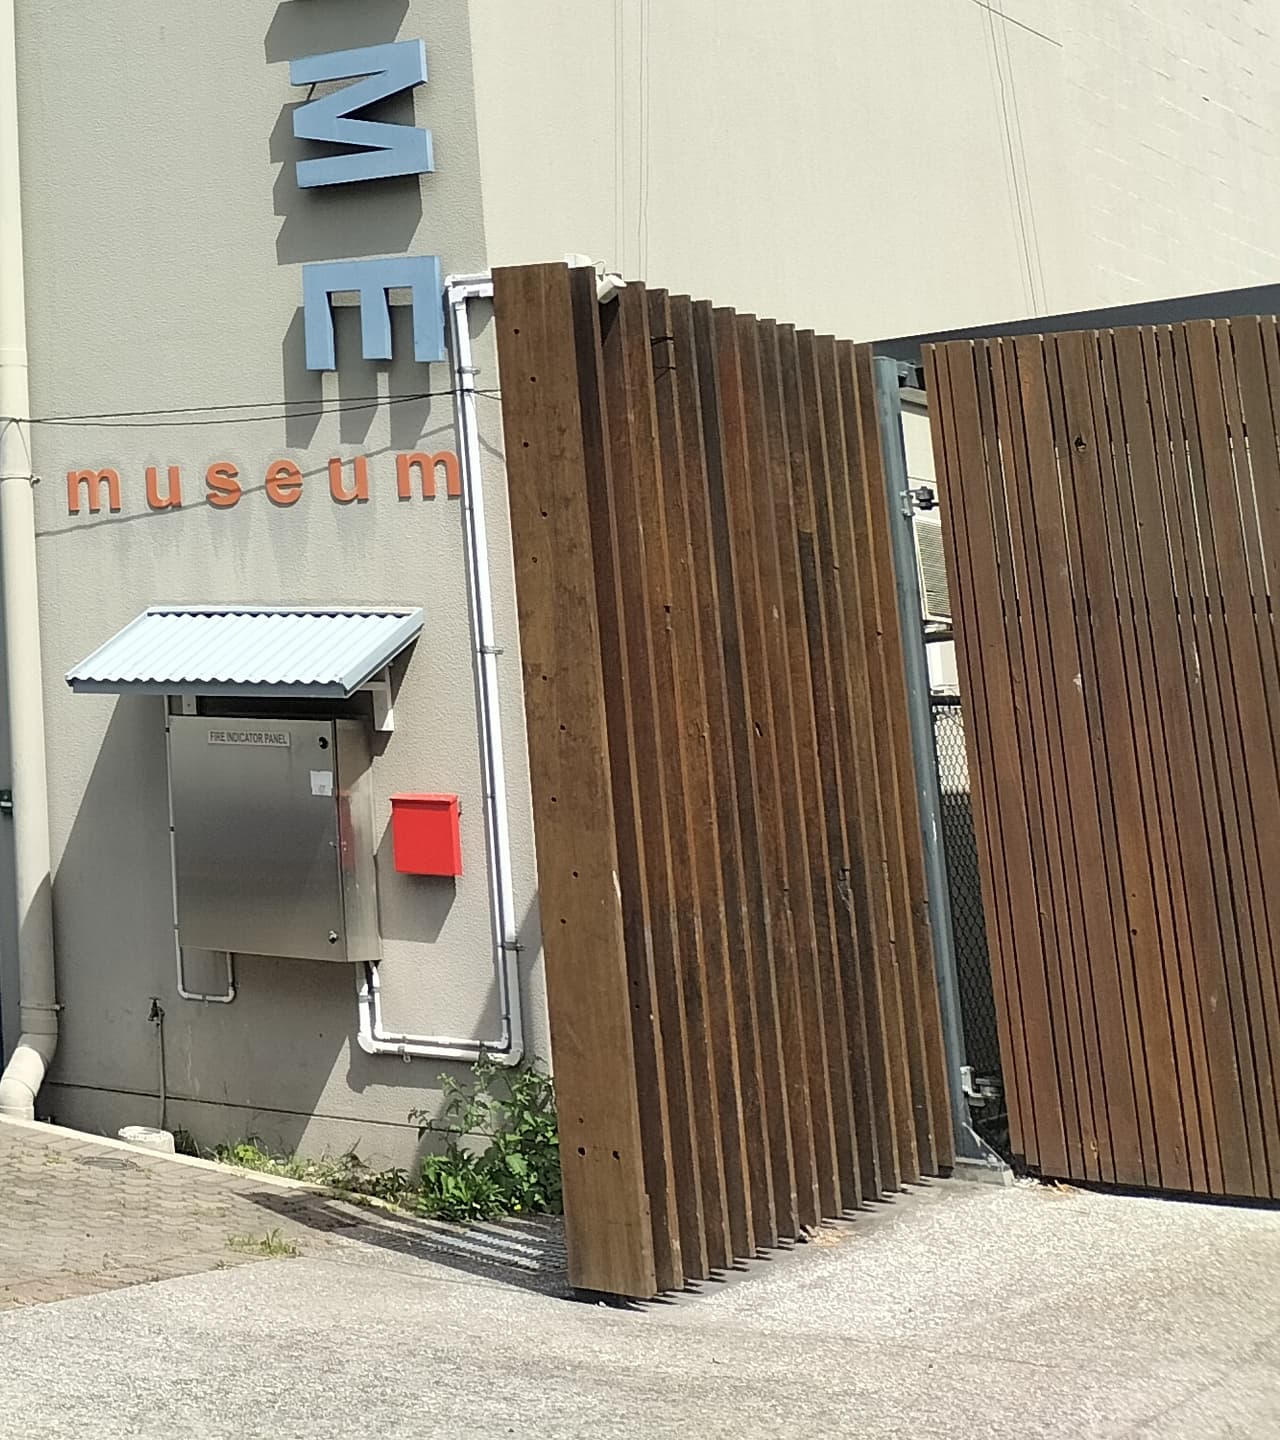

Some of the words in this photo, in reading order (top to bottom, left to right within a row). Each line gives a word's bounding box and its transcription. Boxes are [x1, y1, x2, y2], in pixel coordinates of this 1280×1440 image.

[67, 450, 461, 512] museum
[210, 731, 225, 742] FIRE
[227, 731, 263, 744] INDICATOR
[264, 732, 288, 745] PANEL
